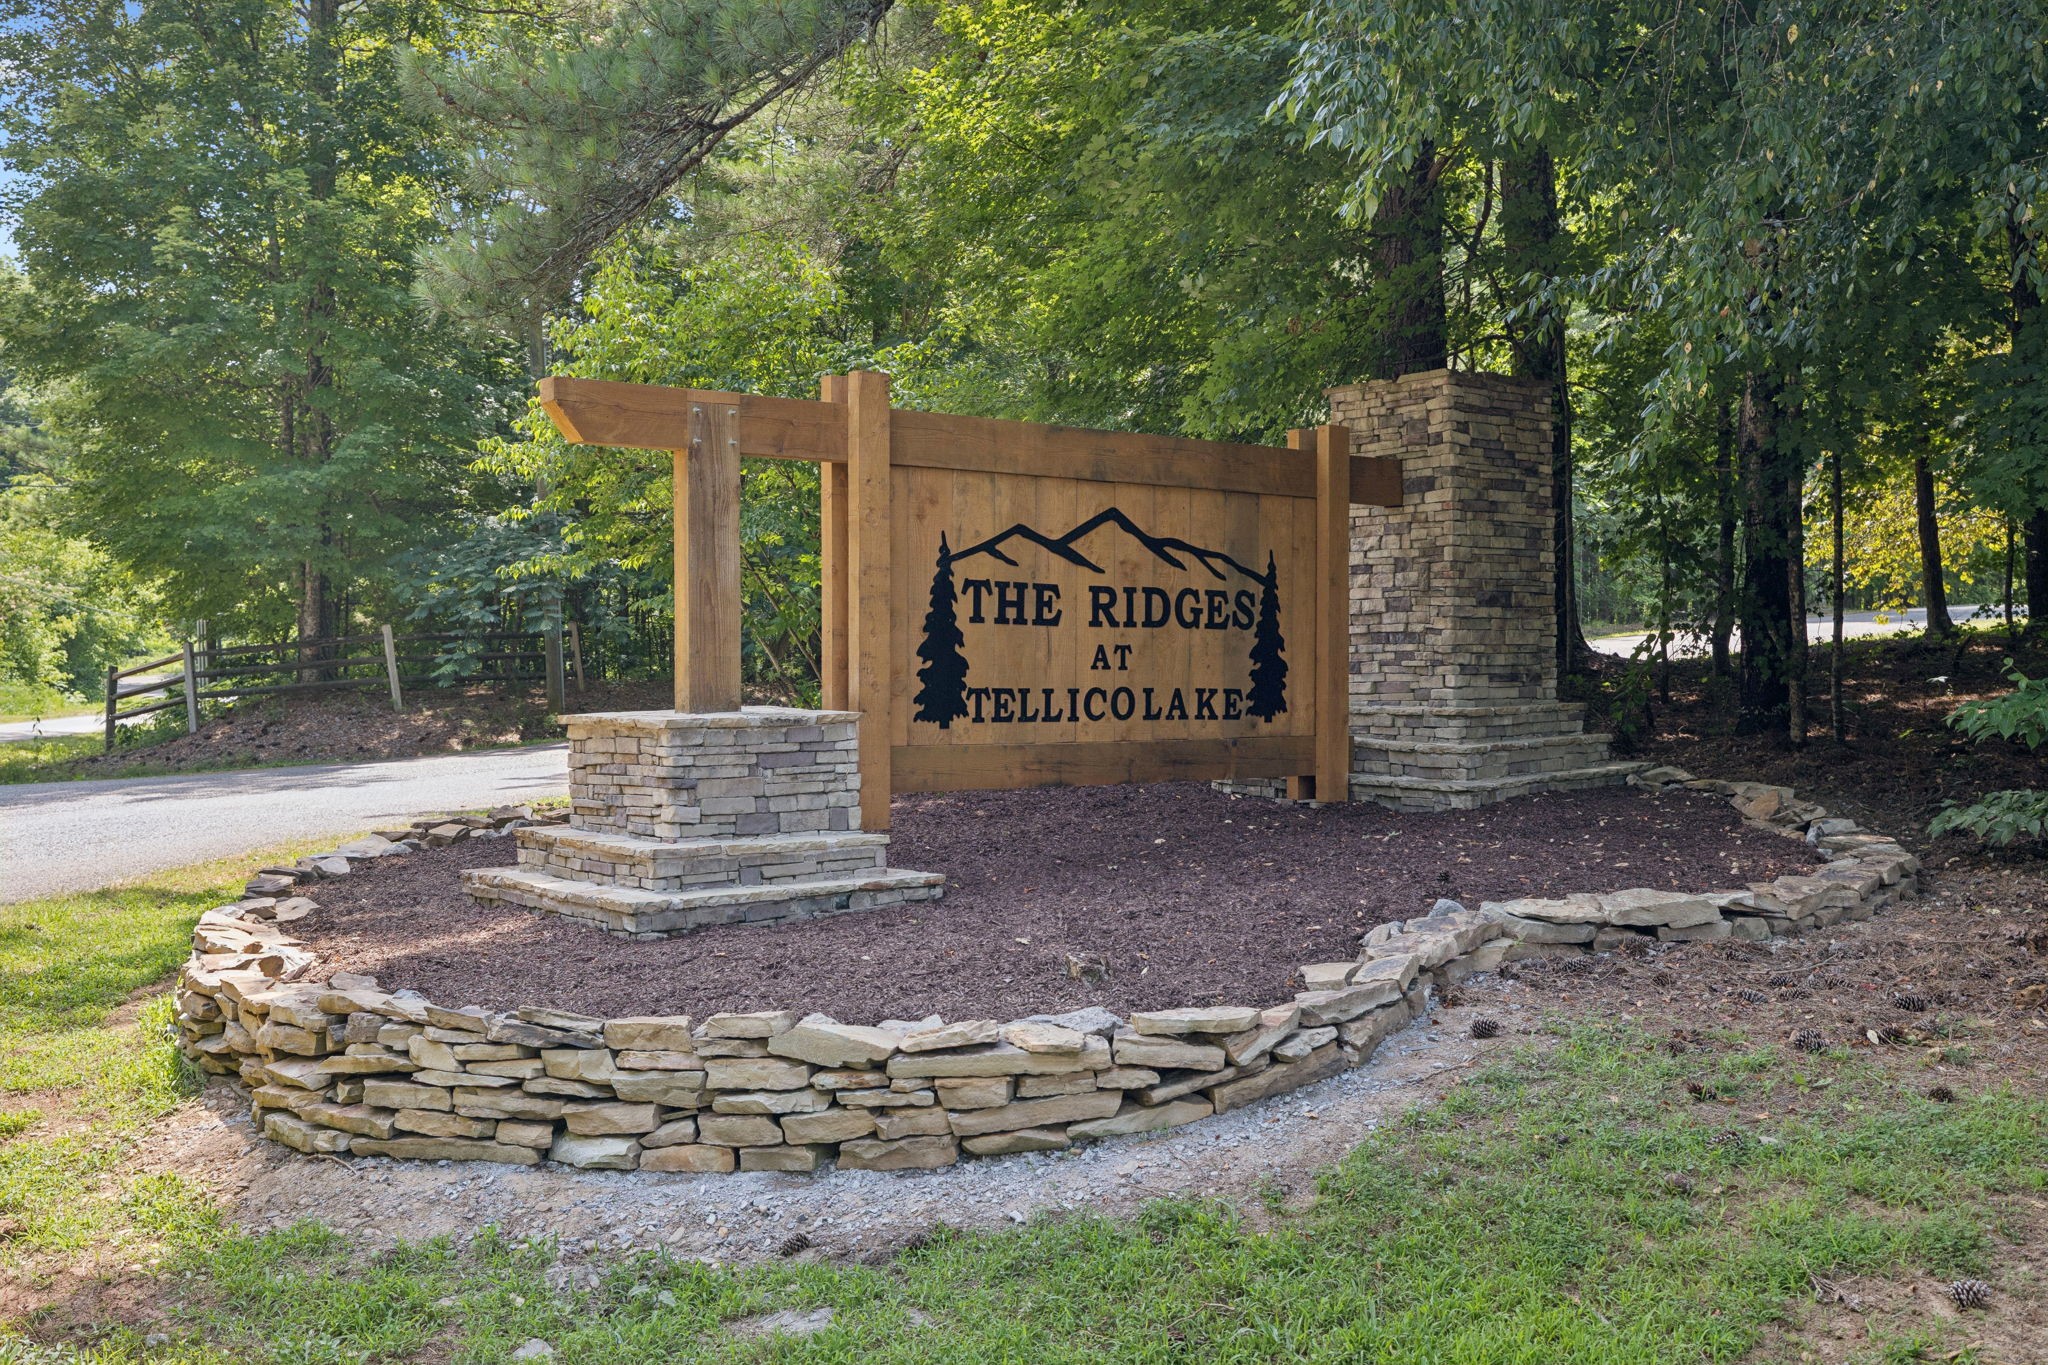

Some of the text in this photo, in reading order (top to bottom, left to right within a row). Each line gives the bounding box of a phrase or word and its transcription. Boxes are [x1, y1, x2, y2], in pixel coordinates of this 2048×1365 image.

[961, 577, 1256, 630] THE RIDGES
[1090, 644, 1133, 671] AT
